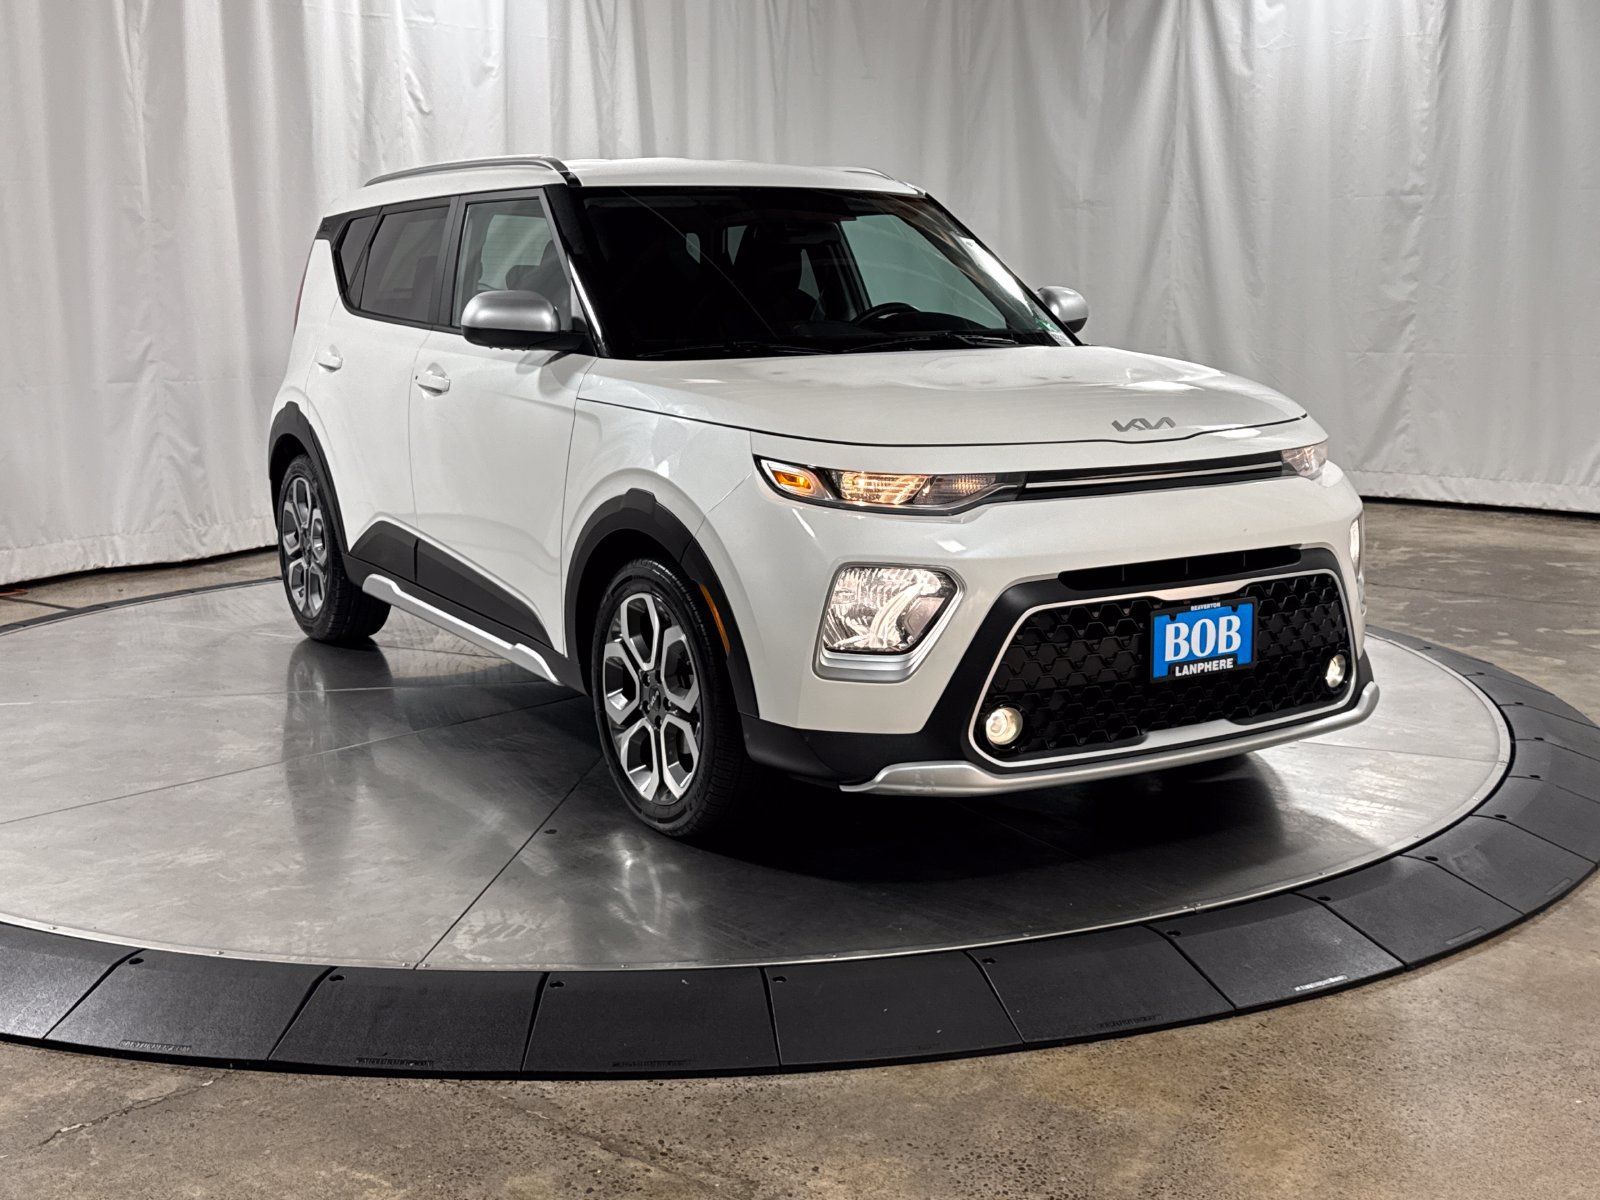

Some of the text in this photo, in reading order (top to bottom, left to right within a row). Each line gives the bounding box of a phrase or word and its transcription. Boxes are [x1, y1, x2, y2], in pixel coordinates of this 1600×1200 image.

[1111, 417, 1176, 432] KIA
[1190, 602, 1221, 611] BEAVERTON
[1165, 615, 1241, 662] BOB
[1175, 658, 1234, 677] LANPHERE
